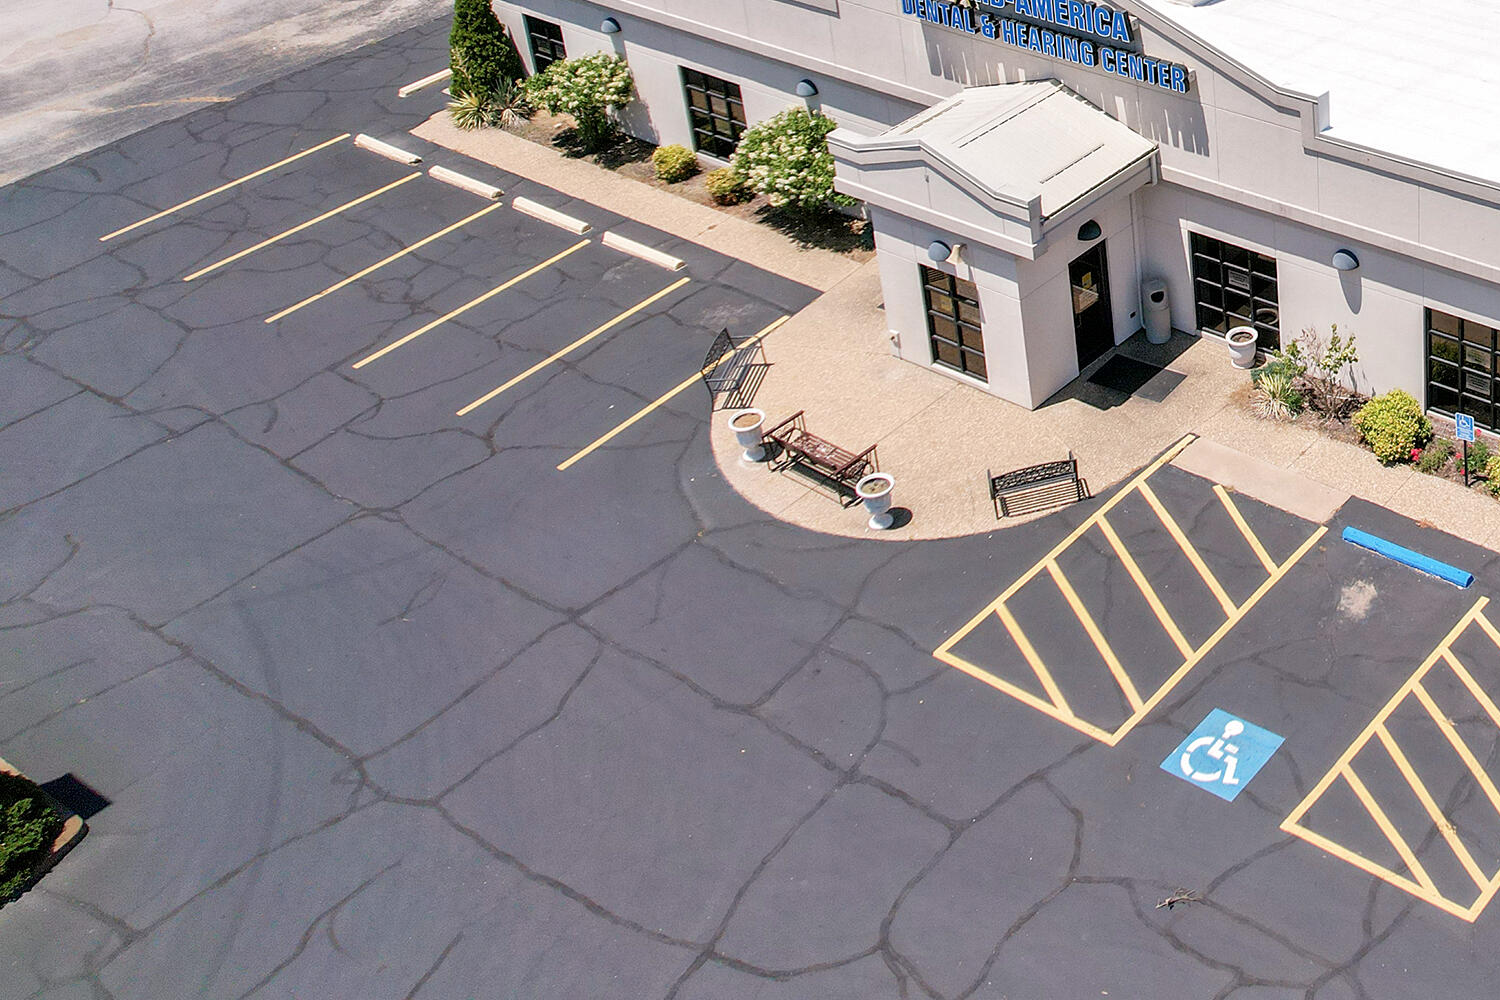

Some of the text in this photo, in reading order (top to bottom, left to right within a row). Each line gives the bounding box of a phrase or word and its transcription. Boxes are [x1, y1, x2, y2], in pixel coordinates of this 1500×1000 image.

[980, 14, 1000, 40] &
[1001, 18, 1096, 67] HEARING
[1100, 45, 1189, 94] CENTER
